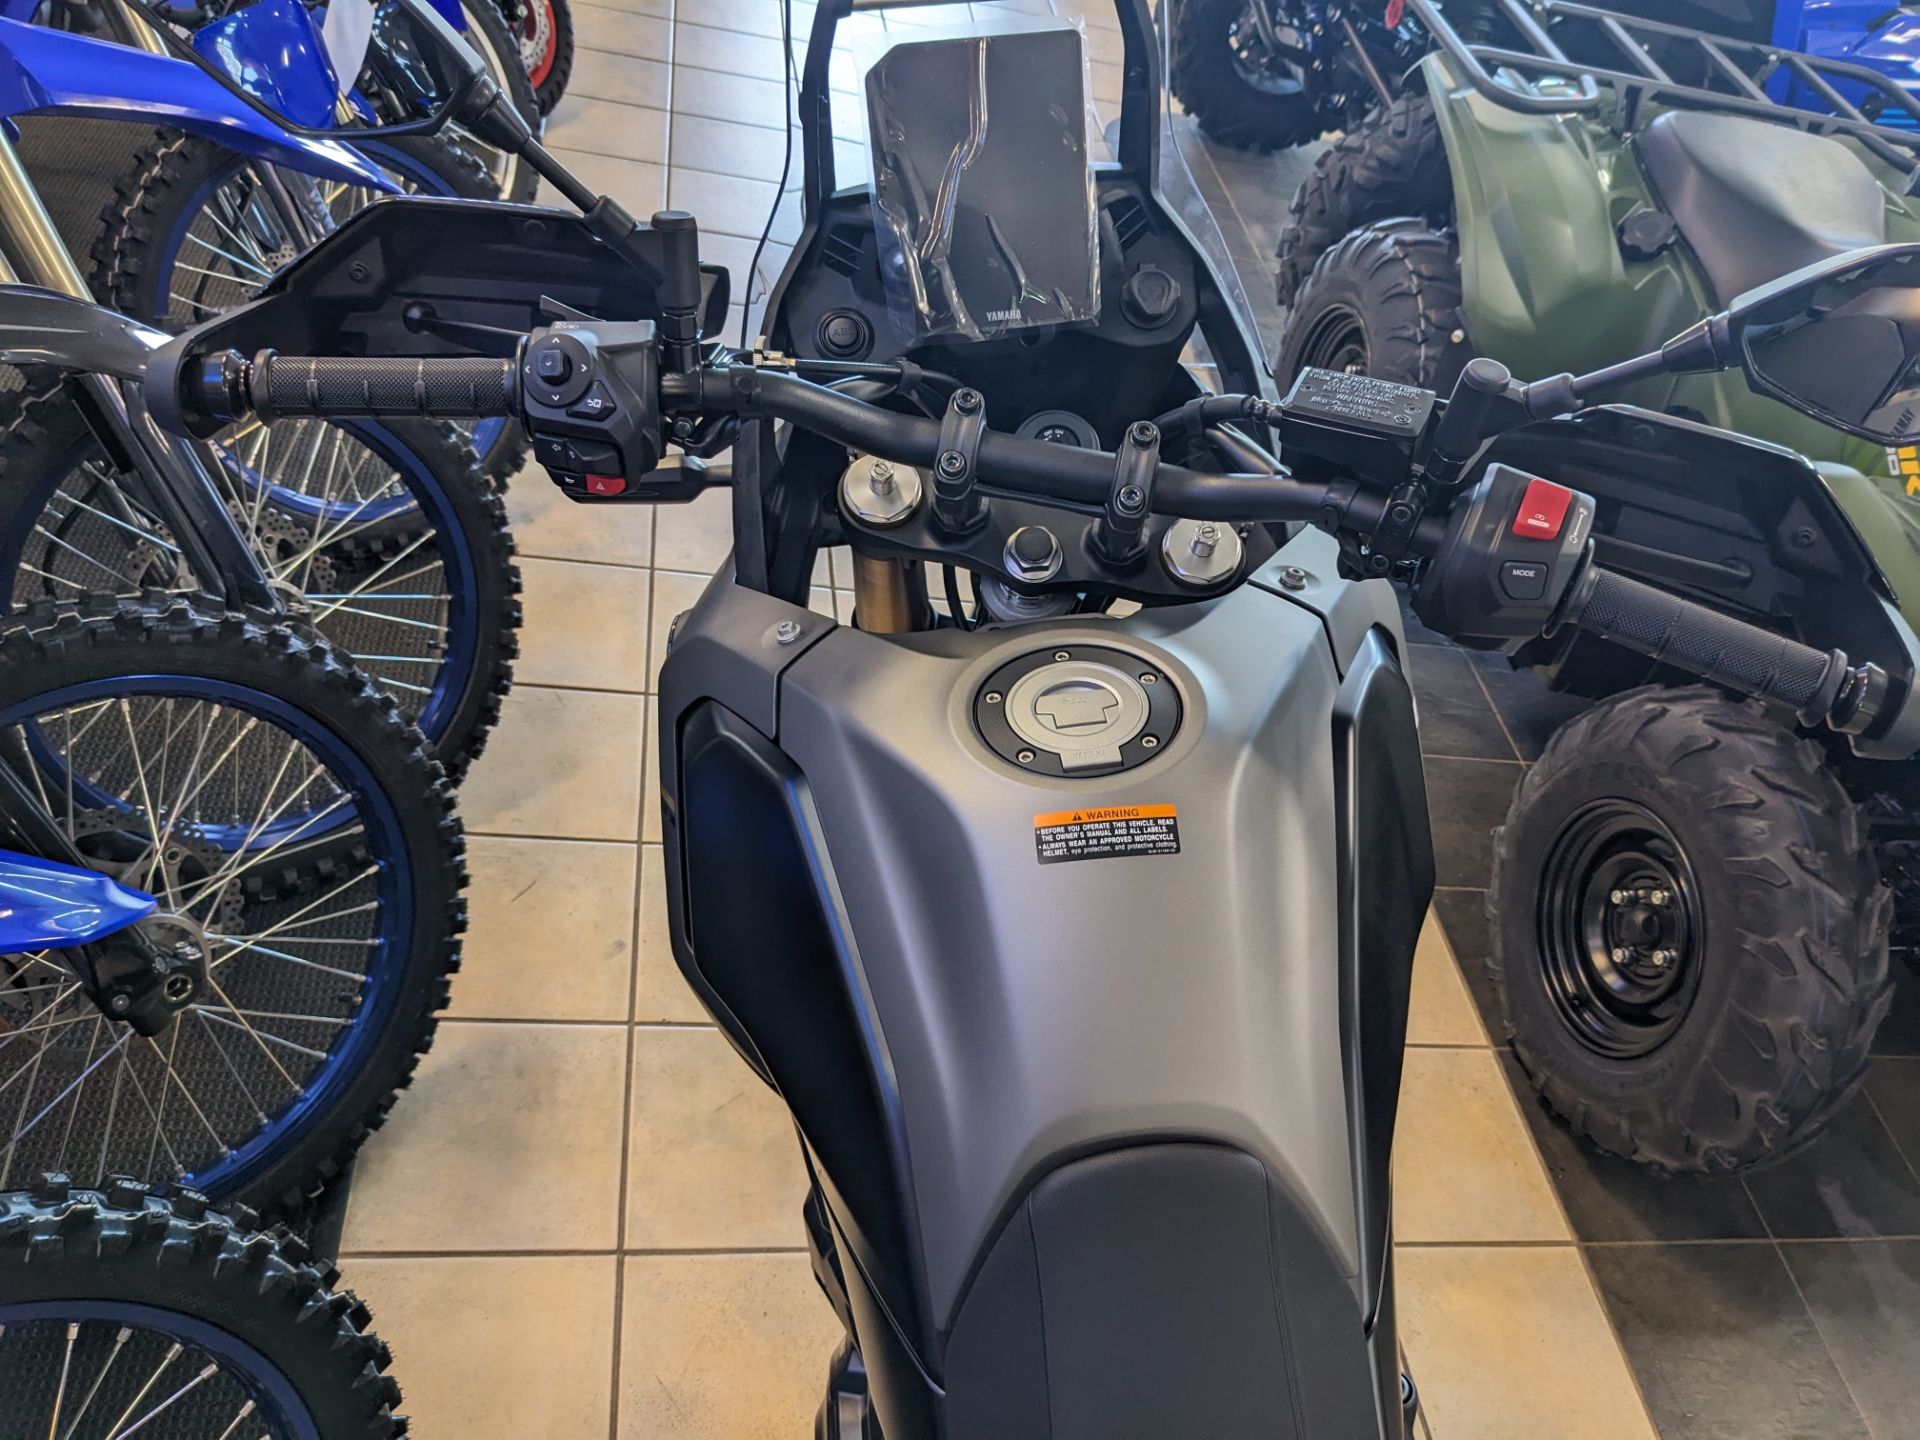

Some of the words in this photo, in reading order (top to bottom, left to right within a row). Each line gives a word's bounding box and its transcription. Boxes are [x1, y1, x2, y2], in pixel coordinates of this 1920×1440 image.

[986, 309, 1022, 322] YAMAHA
[1512, 569, 1536, 577] MODE
[1086, 808, 1140, 820] WARNING
[1041, 826, 1065, 835] BEFORE
[1082, 822, 1110, 830] OPERATE
[1055, 831, 1084, 840] OWNER'S
[1086, 829, 1112, 837] MANUAL
[1042, 841, 1066, 850] ALWAYS
[1100, 836, 1132, 844] APPROVED
[1134, 833, 1174, 842] MOTORCYCLE
[1127, 842, 1154, 850] protective
